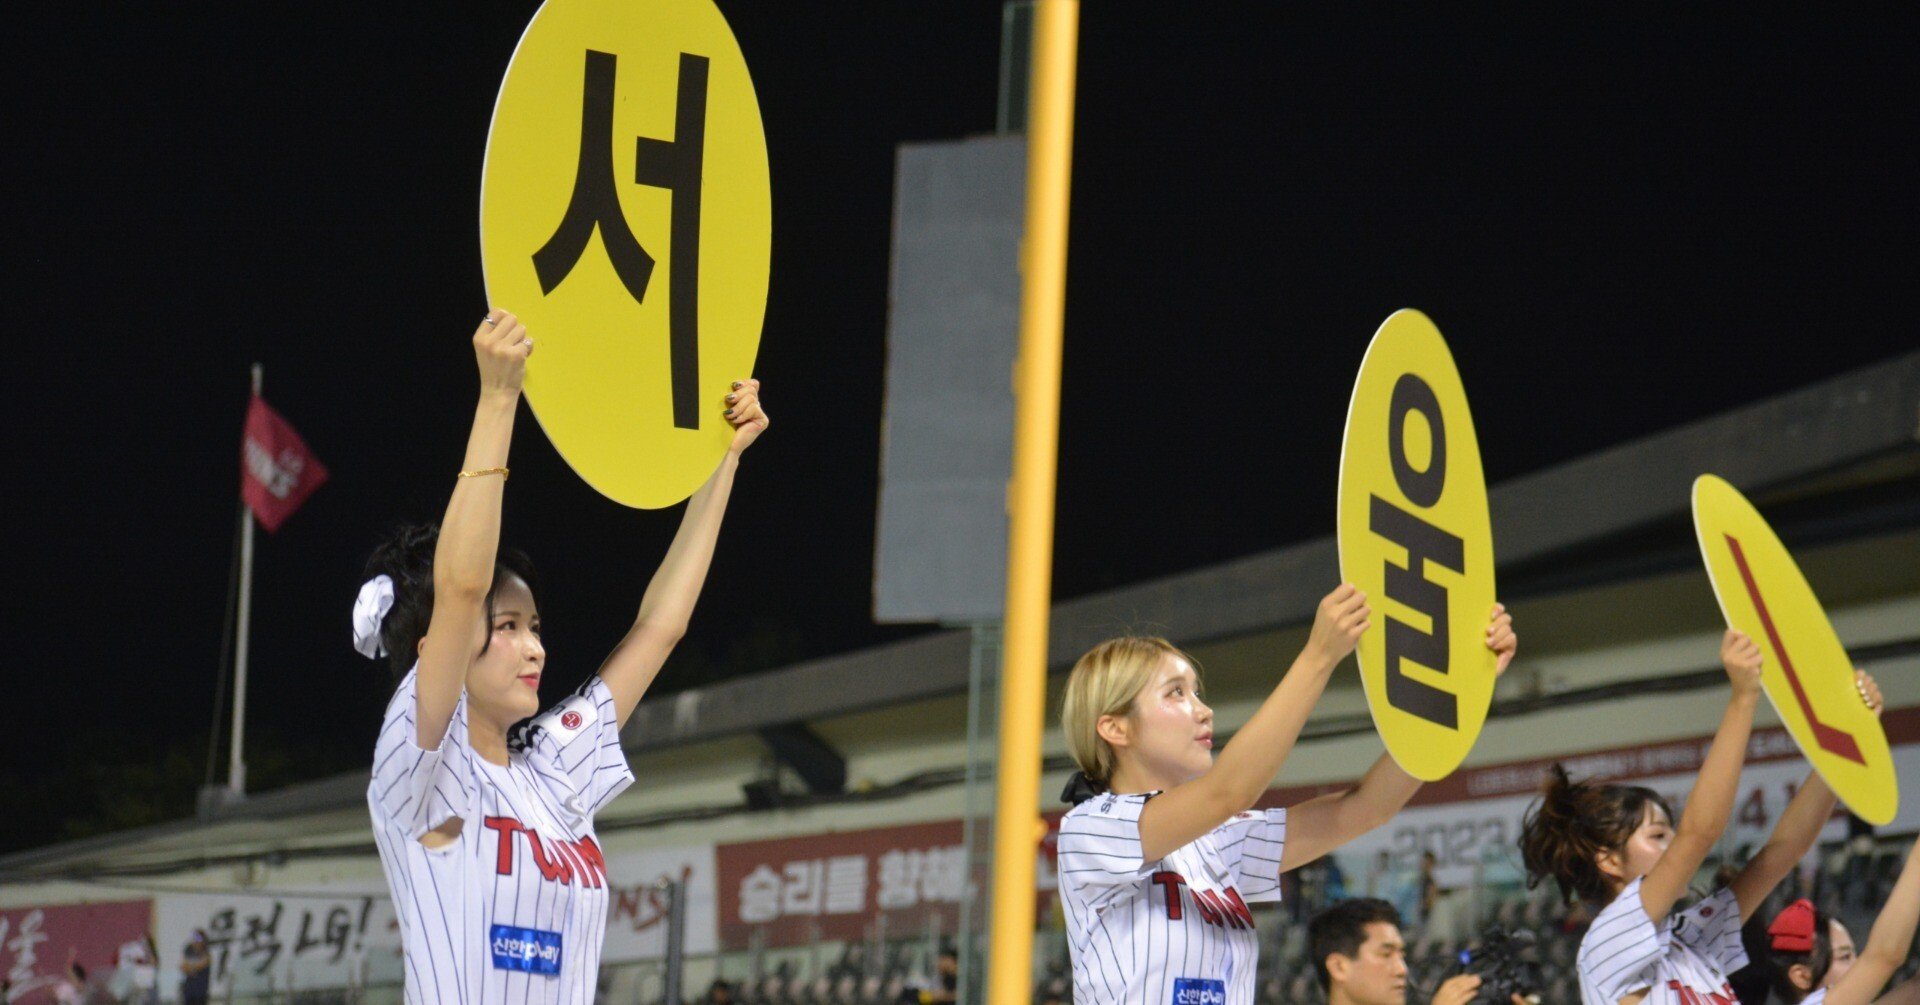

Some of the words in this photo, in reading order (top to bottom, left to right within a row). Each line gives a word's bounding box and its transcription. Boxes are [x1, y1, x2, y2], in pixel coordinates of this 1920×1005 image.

[532, 49, 710, 431] 서
[1369, 372, 1465, 732] 울
[206, 900, 283, 980] 무적
[294, 894, 375, 966] LG!
[738, 853, 868, 923] 승리를
